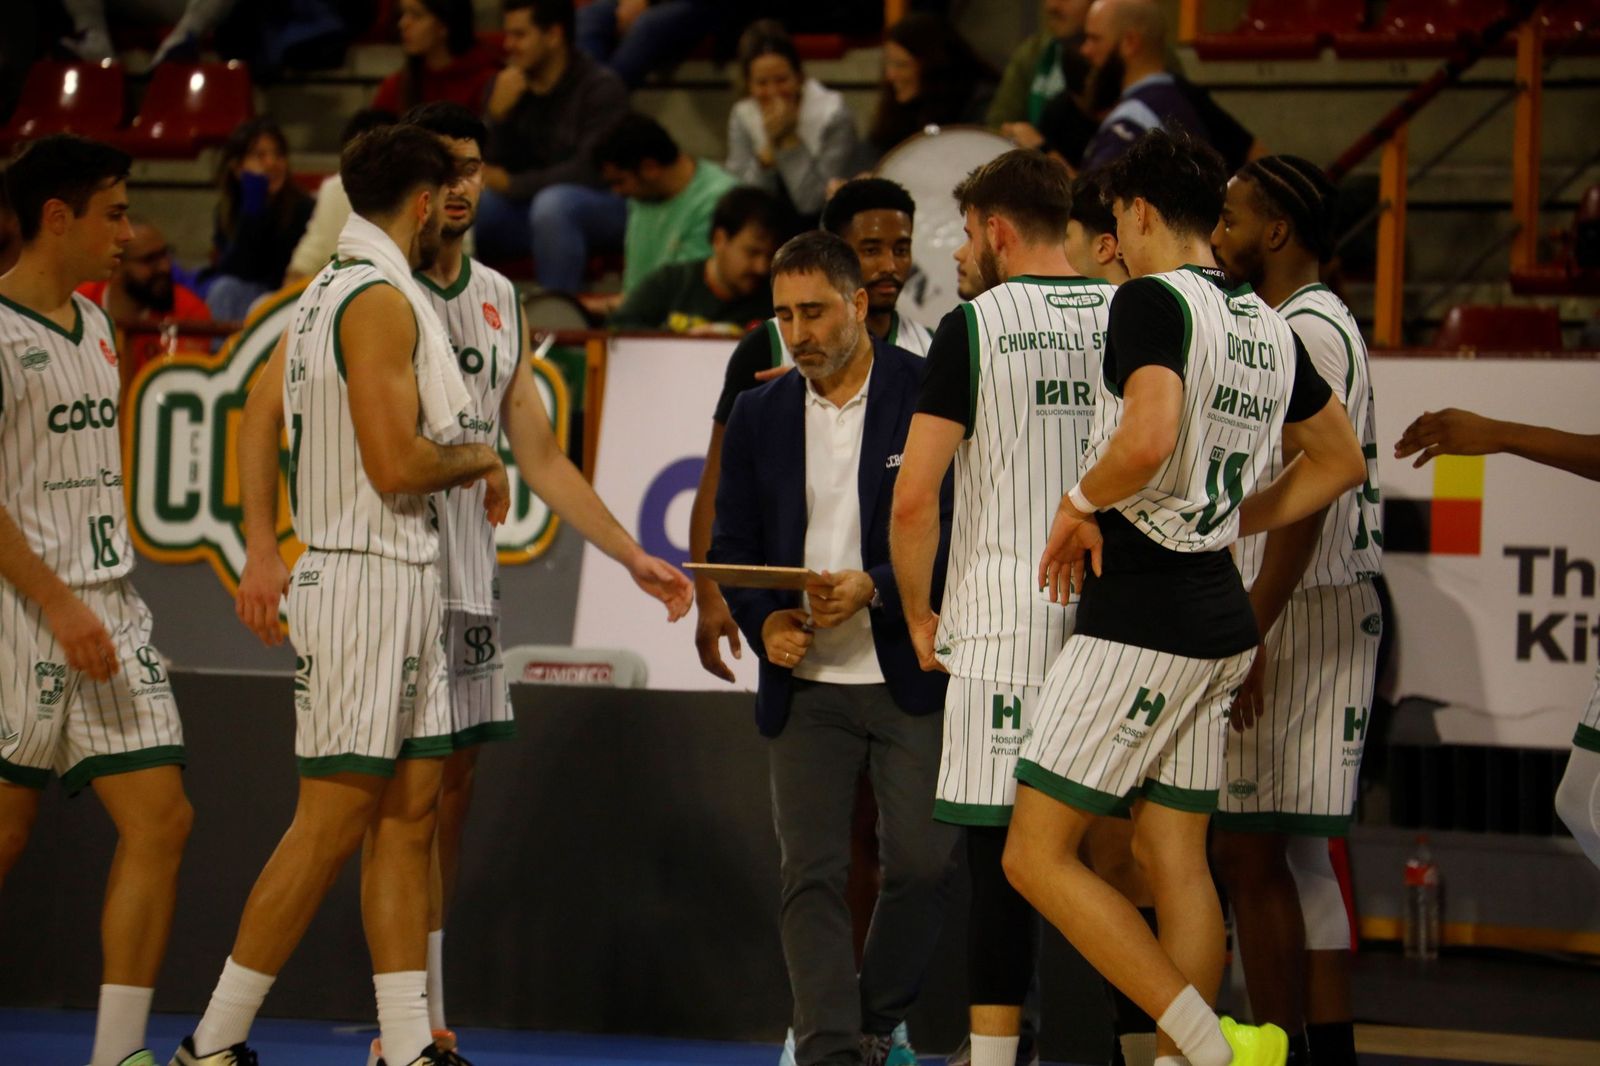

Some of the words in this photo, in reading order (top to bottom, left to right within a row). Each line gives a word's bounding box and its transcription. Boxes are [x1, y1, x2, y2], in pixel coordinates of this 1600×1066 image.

[998, 331, 1085, 354] CHURCHILL
[1036, 409, 1076, 417] SOLUCIONES
[87, 514, 120, 570] 16
[1502, 546, 1600, 597] Th
